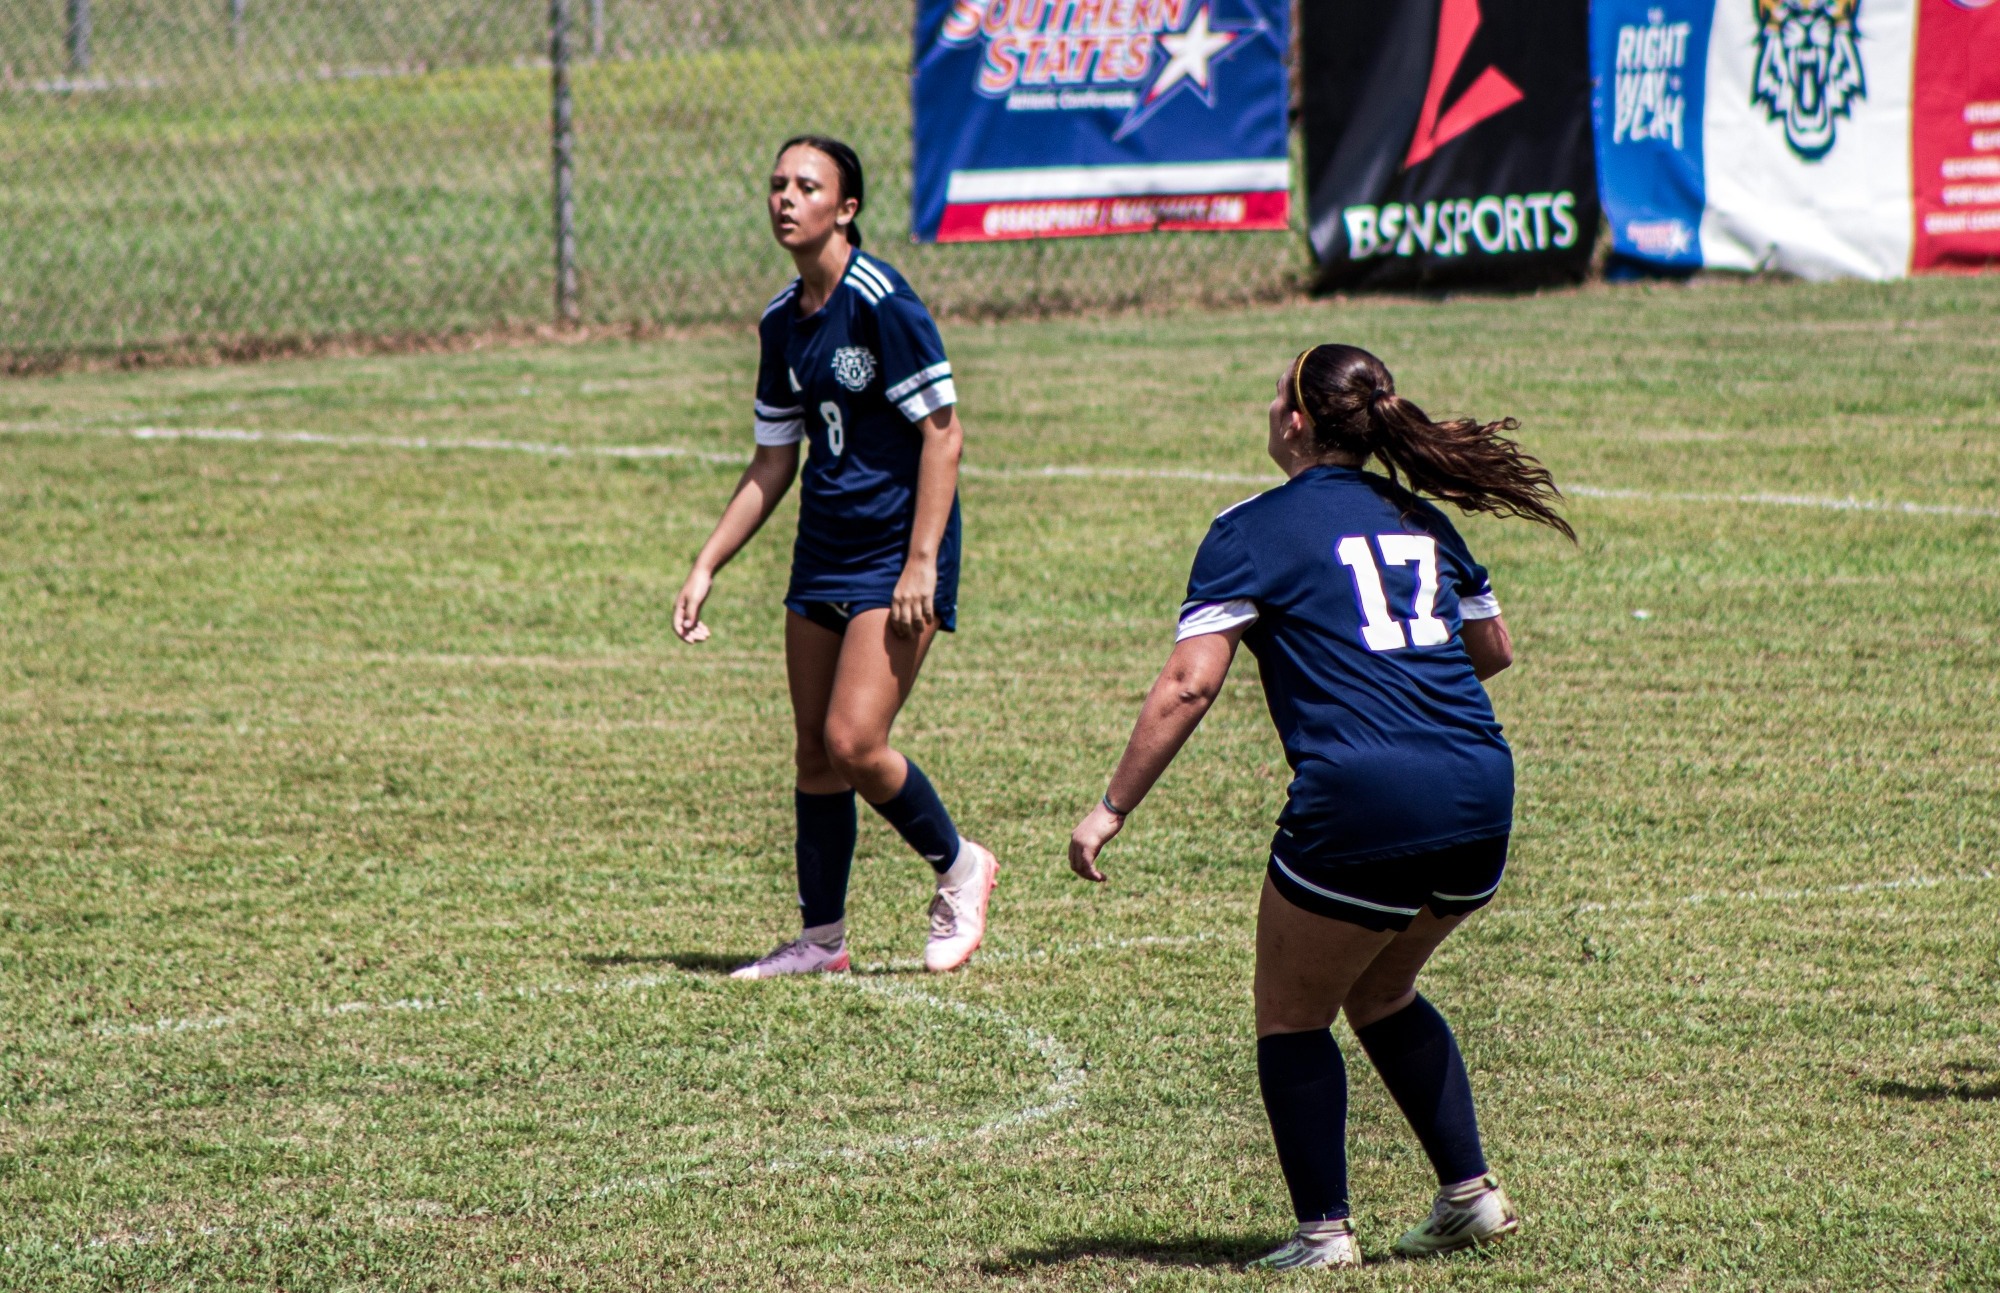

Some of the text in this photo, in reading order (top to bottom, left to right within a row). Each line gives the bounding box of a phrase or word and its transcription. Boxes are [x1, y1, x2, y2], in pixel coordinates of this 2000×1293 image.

[942, 0, 1183, 41] SOUTHERN
[1616, 23, 1690, 70] RIGHT
[979, 34, 1154, 93] STATES
[1614, 70, 1668, 111] WAY
[1612, 95, 1684, 151] PLAY
[820, 401, 844, 457] 8
[1336, 533, 1450, 652] 17
